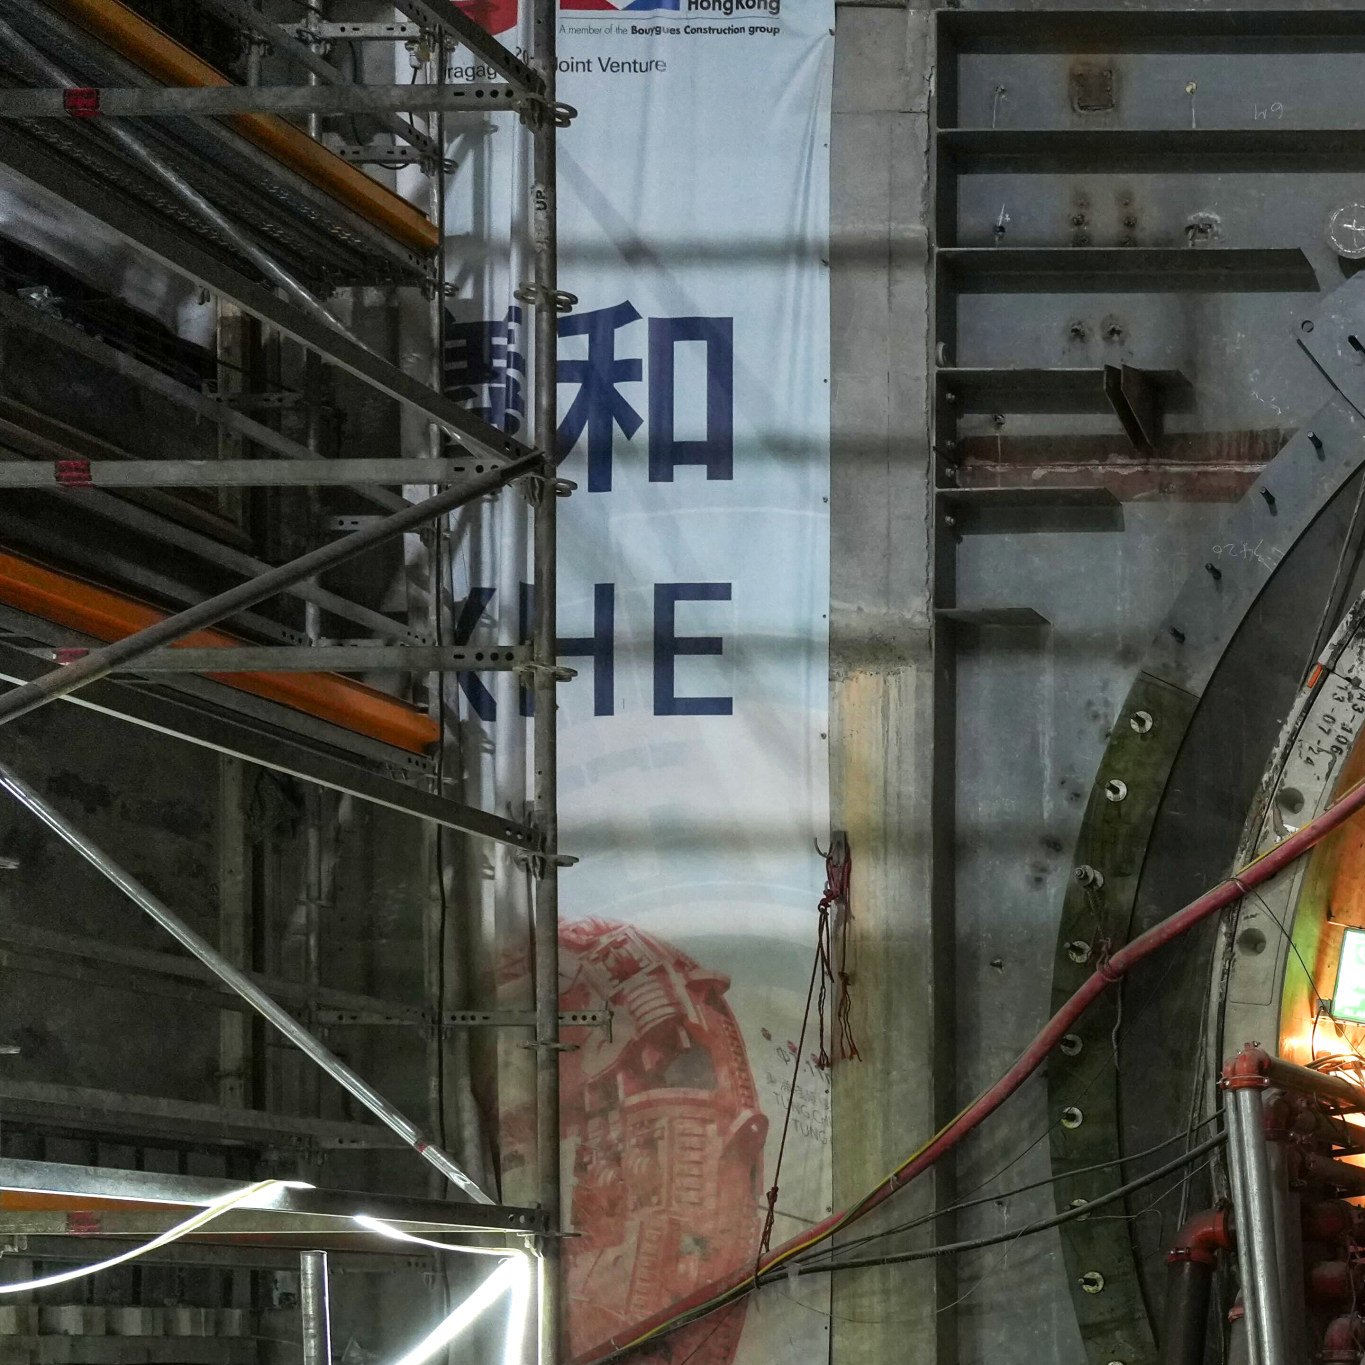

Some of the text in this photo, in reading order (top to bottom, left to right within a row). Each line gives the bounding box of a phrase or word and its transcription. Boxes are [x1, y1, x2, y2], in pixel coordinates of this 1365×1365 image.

[559, 24, 781, 37] A member of the Bouygues Construction group
[598, 56, 667, 73] Venture
[1303, 684, 1348, 767] 13-07-24
